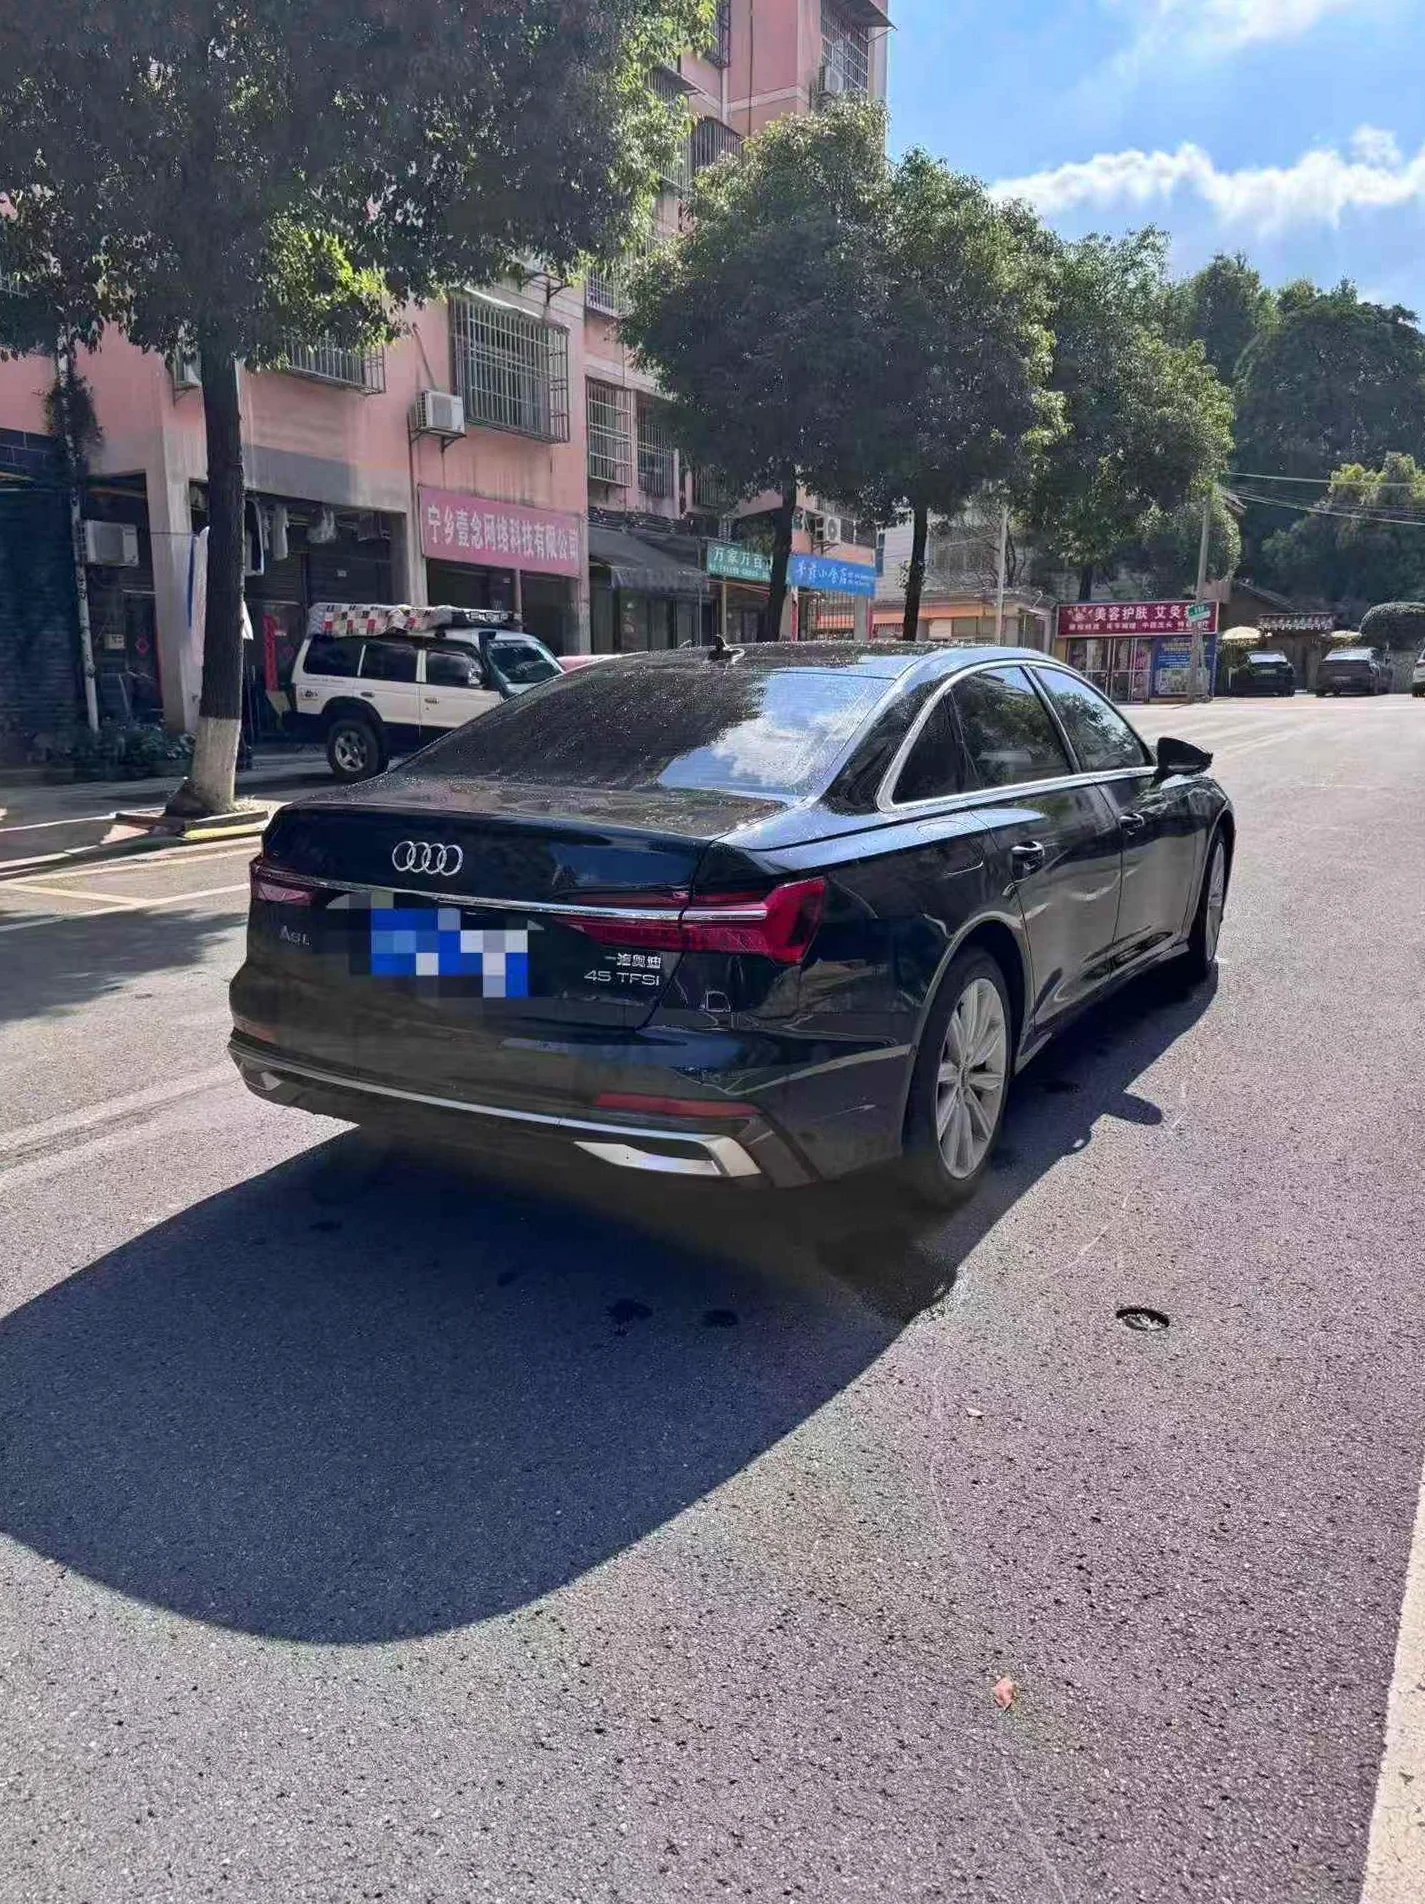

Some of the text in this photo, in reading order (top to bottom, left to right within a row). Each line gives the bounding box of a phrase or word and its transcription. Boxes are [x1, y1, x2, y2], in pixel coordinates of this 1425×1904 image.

[428, 504, 579, 561] 宁乡壹念网络科技有限公司
[1094, 605, 1148, 622] 美容护肤
[583, 970, 660, 986] 45 TFSI
